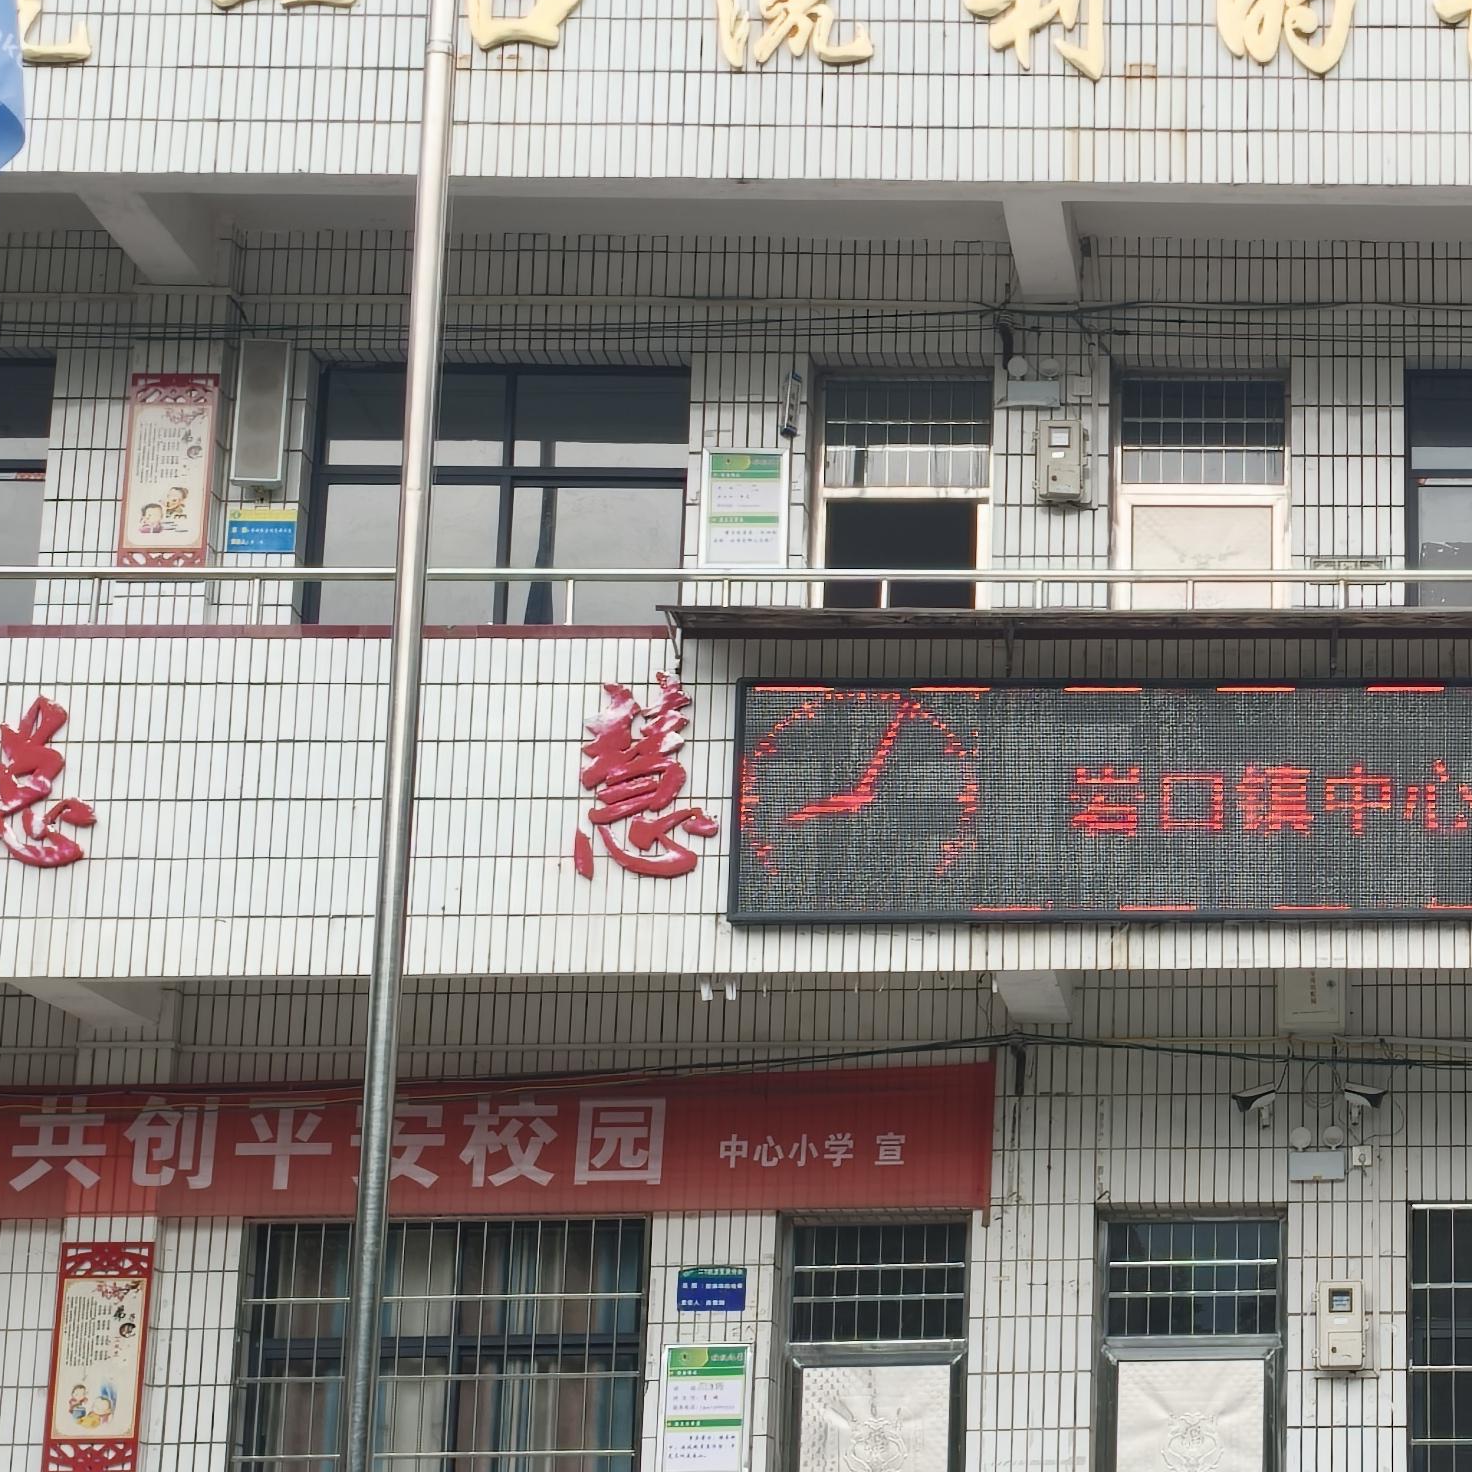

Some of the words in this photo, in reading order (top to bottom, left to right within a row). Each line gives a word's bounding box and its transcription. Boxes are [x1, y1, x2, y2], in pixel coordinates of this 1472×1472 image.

[9, 1093, 668, 1192] 共创平安校园
[717, 1132, 856, 1169] 中心小学
[874, 1131, 907, 1168] 宣
